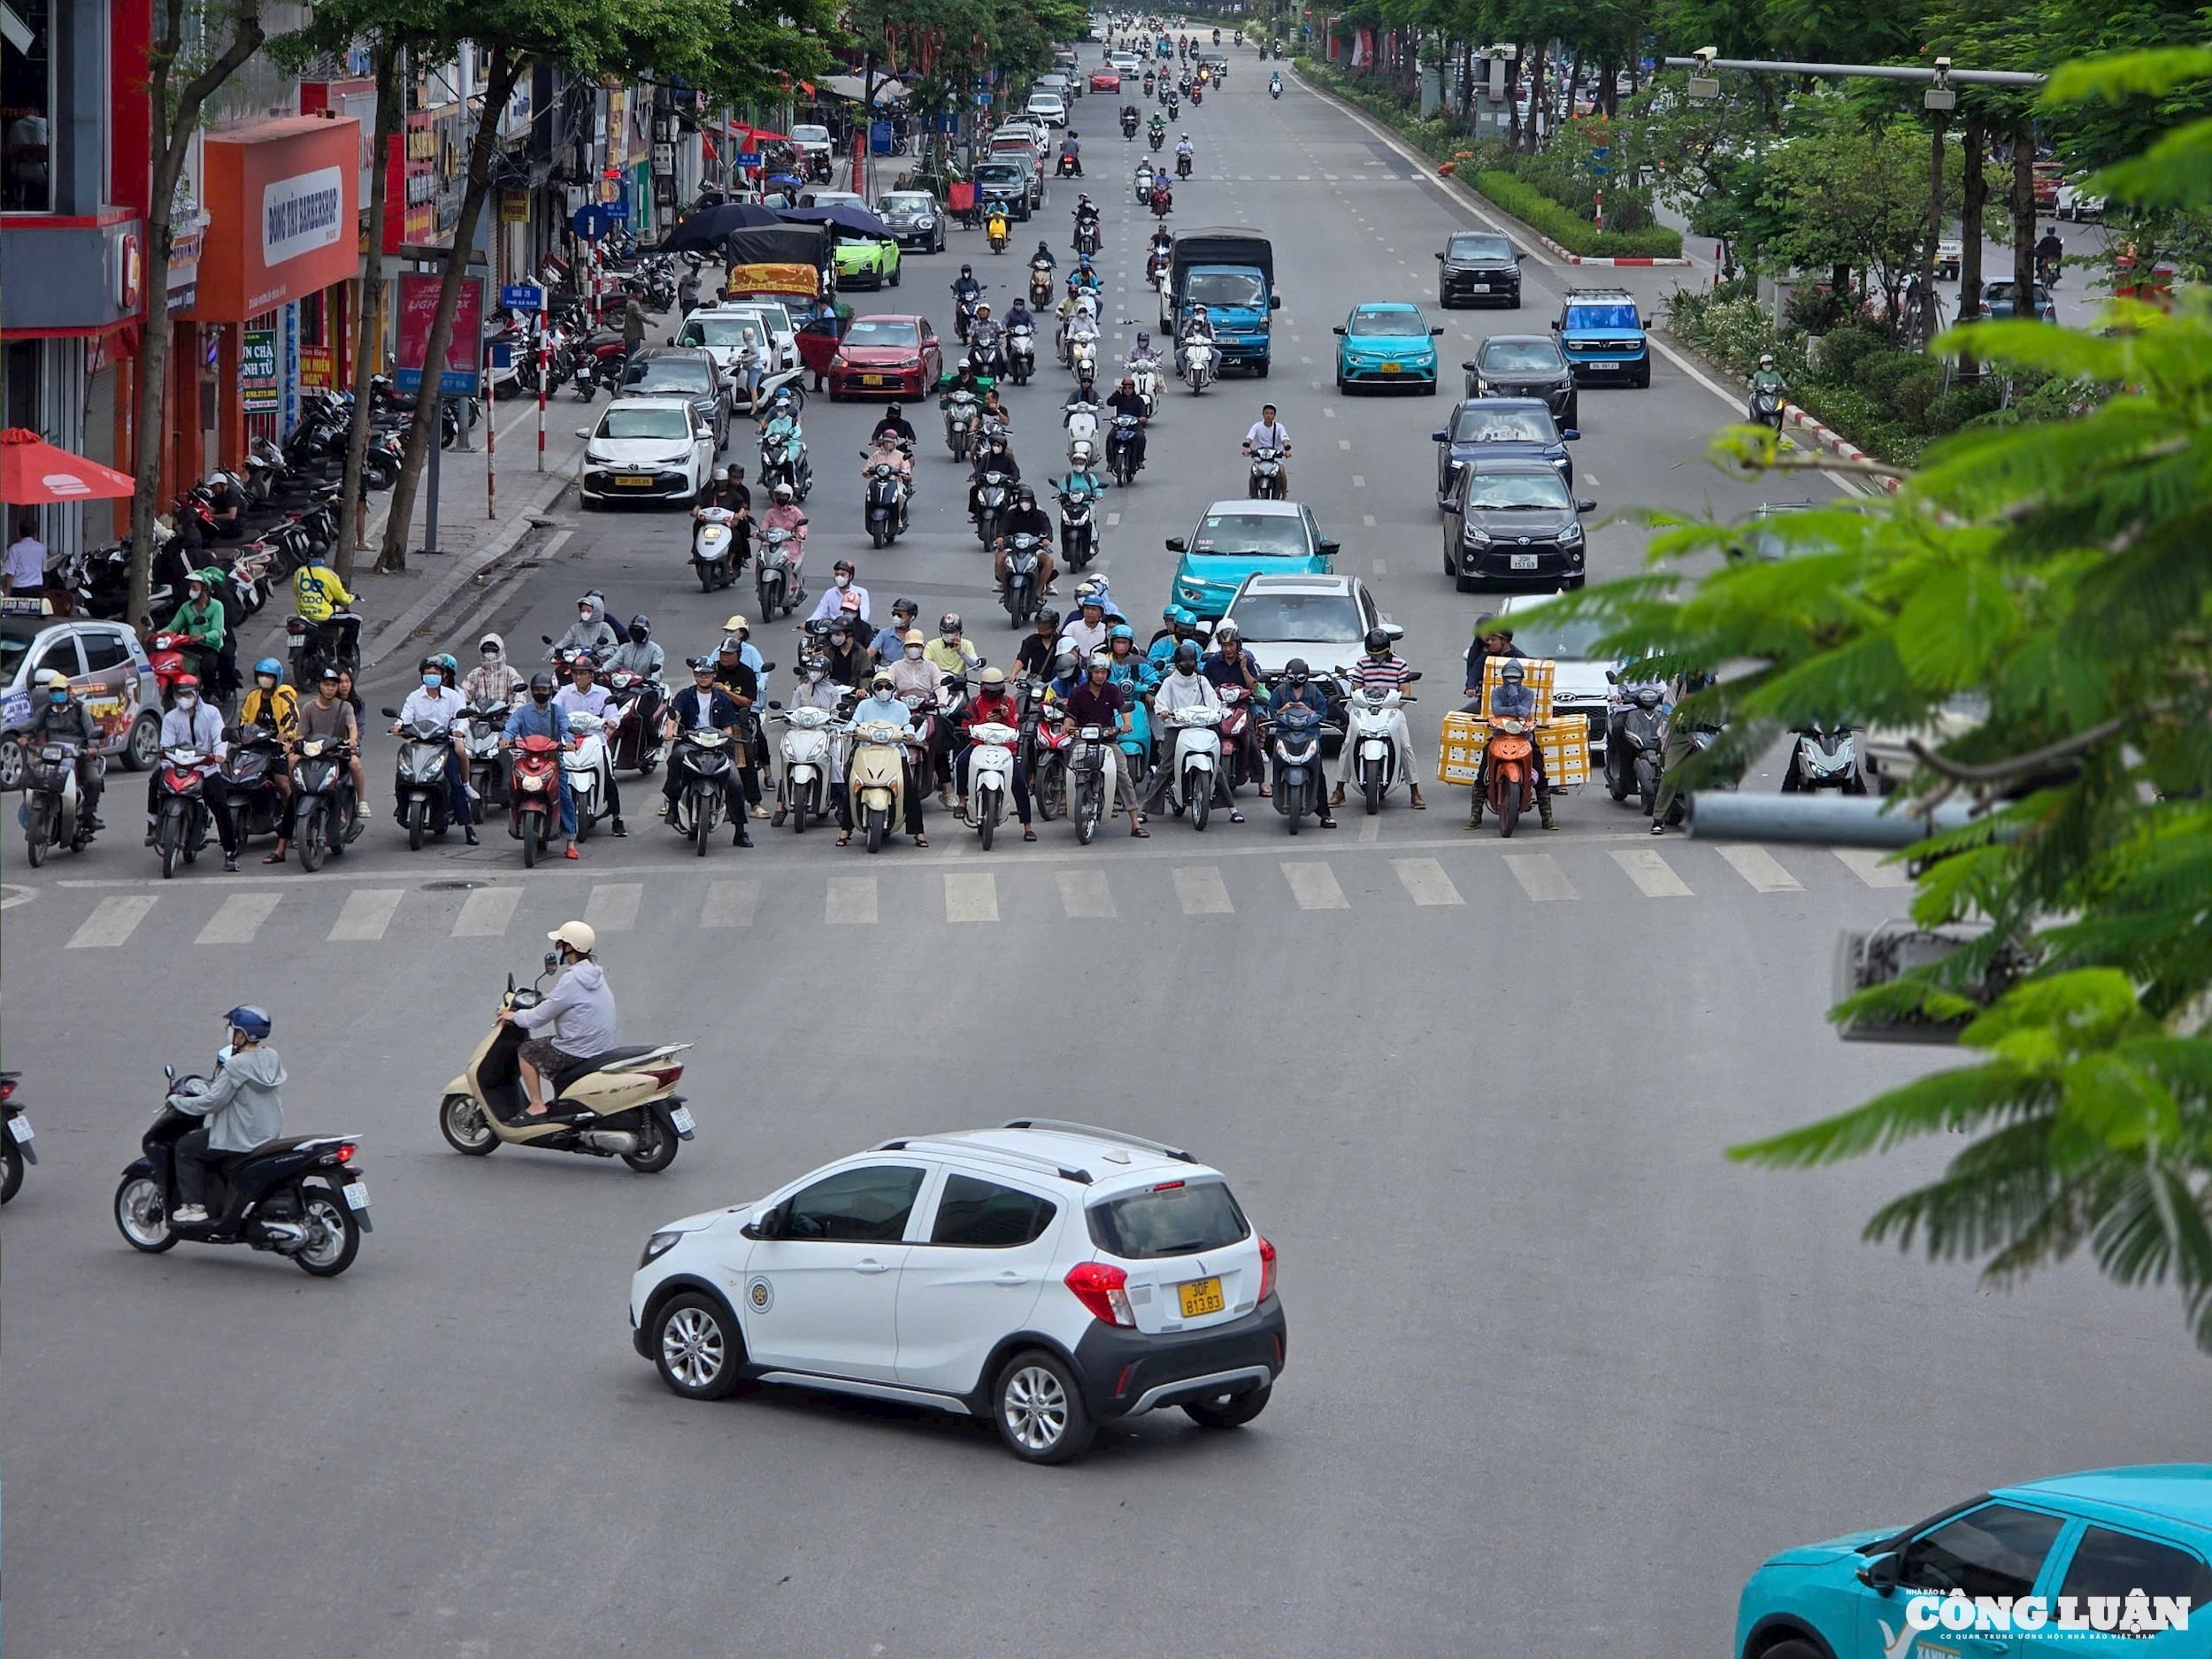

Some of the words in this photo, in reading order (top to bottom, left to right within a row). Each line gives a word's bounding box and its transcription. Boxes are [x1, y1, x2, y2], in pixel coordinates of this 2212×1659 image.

[299, 187, 338, 234] BARBERSHOP
[1192, 1282, 1210, 1297] 30F
[1187, 1295, 1220, 1314] 813.83
